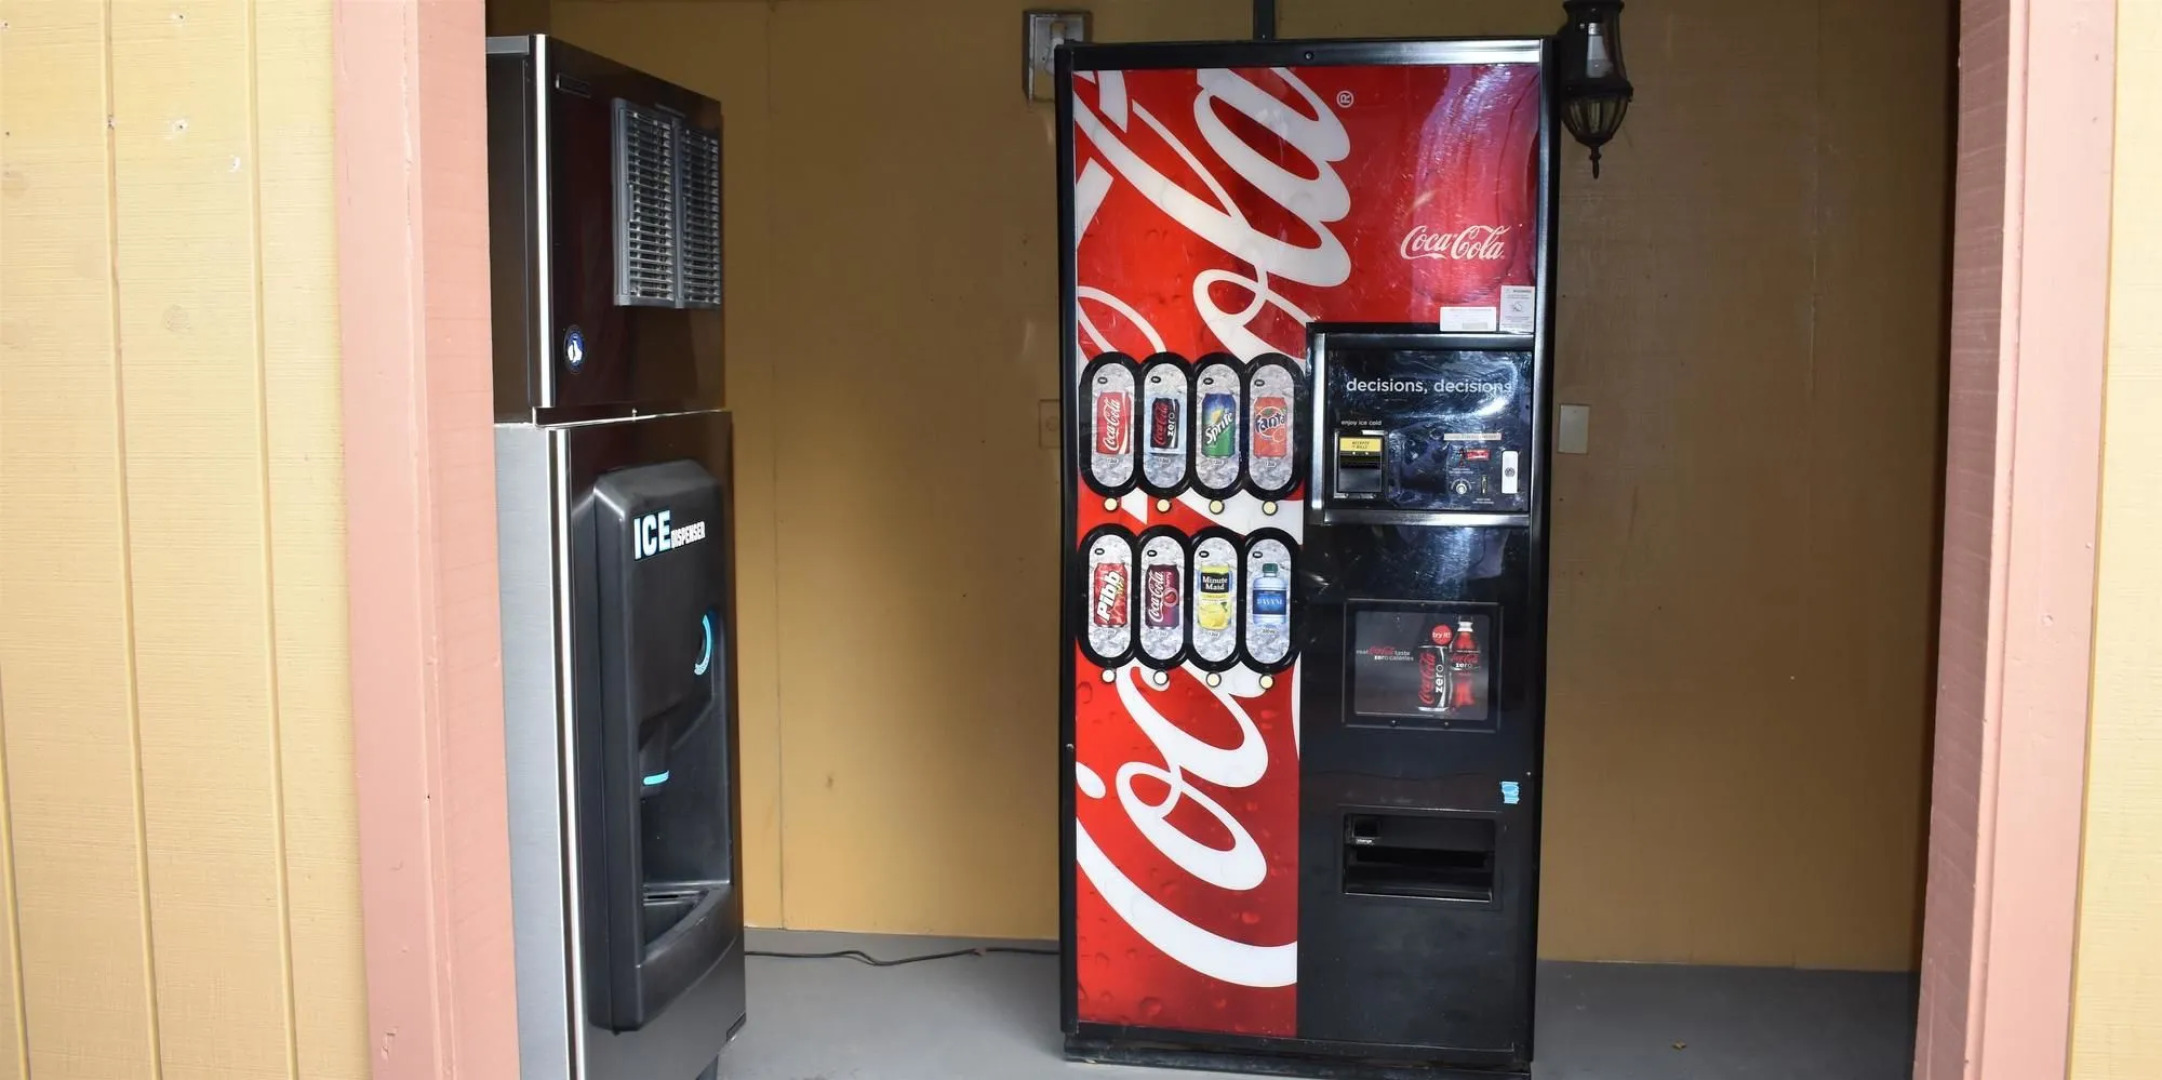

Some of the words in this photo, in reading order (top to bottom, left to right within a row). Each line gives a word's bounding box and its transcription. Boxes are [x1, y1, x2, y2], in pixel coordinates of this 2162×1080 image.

[1400, 225, 1511, 260] Coca-Cola
[1346, 378, 1428, 395] decisions,
[1434, 379, 1512, 393] decisions
[1167, 412, 1175, 437] zero
[1205, 408, 1233, 445] Sprite
[634, 510, 671, 560] ICE
[1202, 575, 1228, 584] Minute
[1205, 583, 1225, 591] Maid
[1097, 571, 1121, 622] Pibb
[1435, 664, 1444, 693] zero
